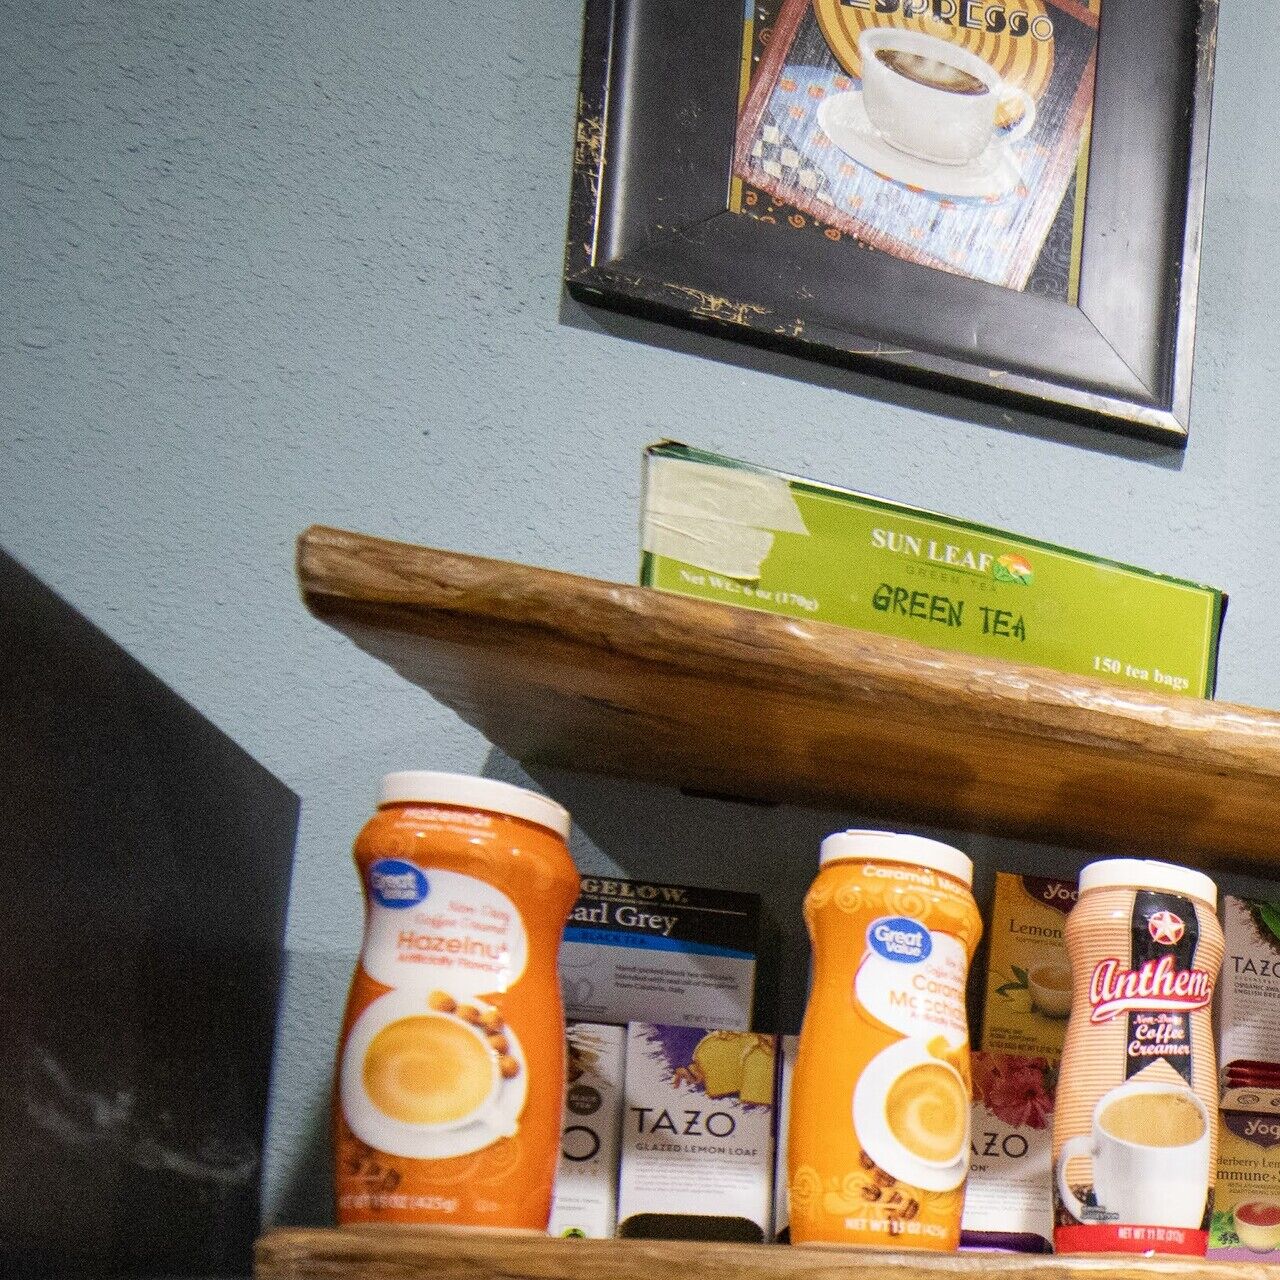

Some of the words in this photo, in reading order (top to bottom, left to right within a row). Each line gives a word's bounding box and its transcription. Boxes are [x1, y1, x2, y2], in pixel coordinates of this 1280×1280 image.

[871, 527, 921, 557] SUN
[928, 538, 994, 572] LEAF
[872, 582, 965, 628] GREEN
[979, 606, 1027, 642] TEA
[1093, 656, 1121, 674] 150
[1125, 664, 1149, 682] tea
[1153, 667, 1190, 692] bags
[863, 865, 935, 885] Caramel
[581, 879, 685, 901] GELOW
[567, 902, 609, 924] arl
[614, 905, 679, 937] Grey
[1009, 919, 1063, 939] Lemon
[875, 925, 923, 947] Great
[912, 974, 965, 1000] Caram
[1090, 954, 1211, 1006] Anthem
[1135, 1023, 1187, 1044] Coffee
[1128, 1040, 1192, 1057] Creamer
[631, 1108, 736, 1138] TAZO
[635, 1142, 682, 1153] GLAZED
[685, 1144, 726, 1155] LEMON
[728, 1148, 758, 1157] LOAF
[970, 1131, 1029, 1159] ZO
[1217, 1156, 1260, 1169] derberry
